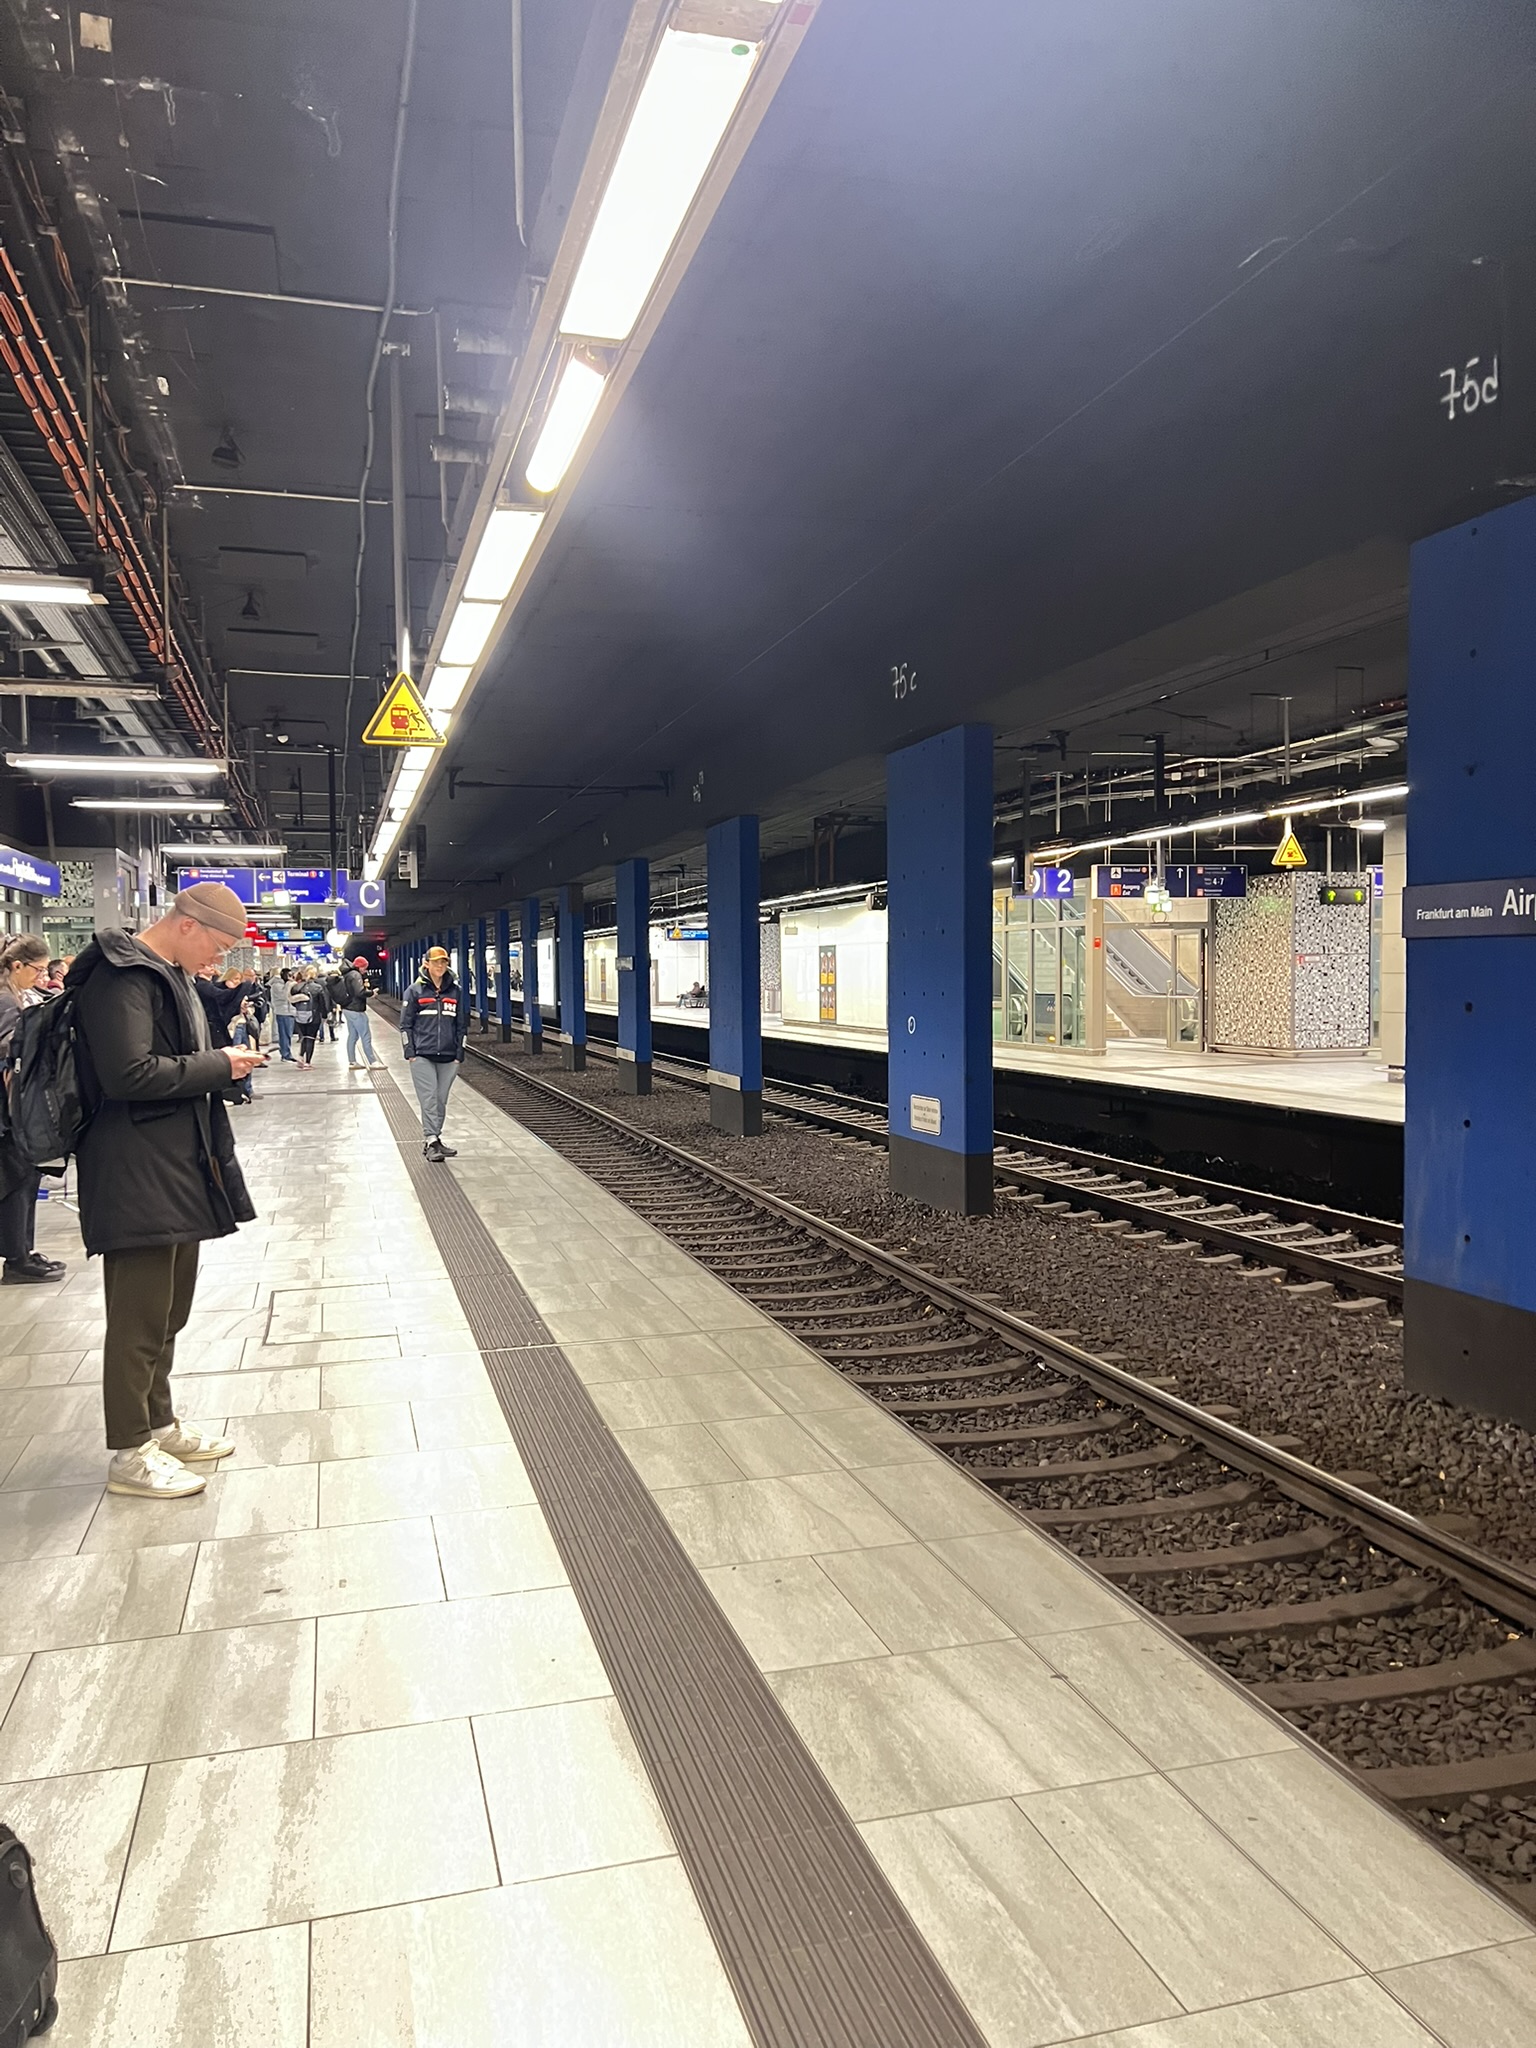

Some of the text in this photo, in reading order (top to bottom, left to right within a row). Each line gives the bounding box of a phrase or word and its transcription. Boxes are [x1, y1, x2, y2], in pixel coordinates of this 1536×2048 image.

[1057, 869, 1071, 892] 2
[359, 881, 381, 908] C
[1416, 888, 1536, 921] Frankfurt am Main Air
